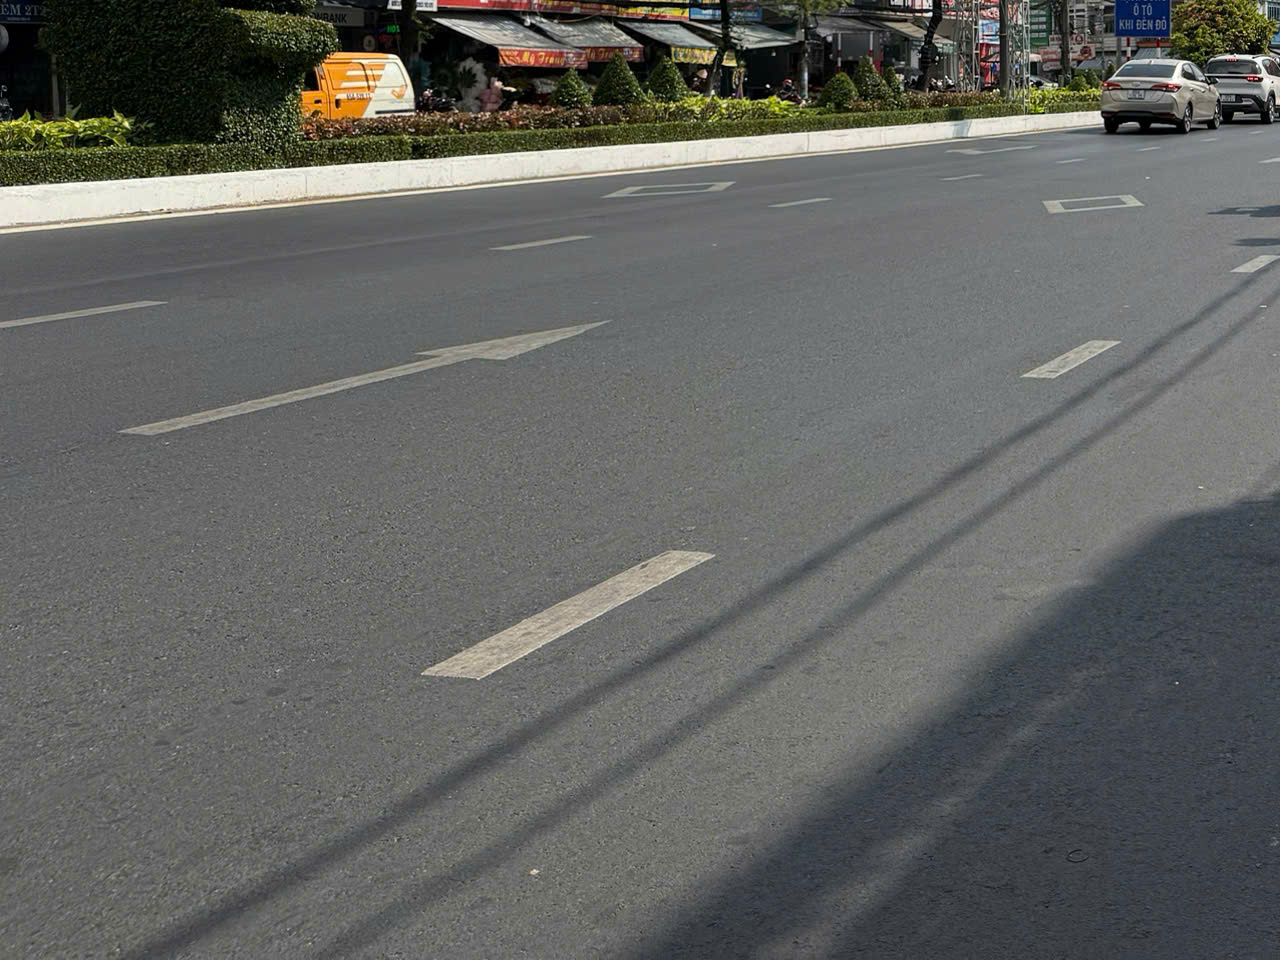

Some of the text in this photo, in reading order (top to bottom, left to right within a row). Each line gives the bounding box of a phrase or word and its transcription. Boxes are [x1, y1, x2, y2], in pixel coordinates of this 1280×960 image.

[1133, 3, 1153, 16] Ô TÔ
[1118, 16, 1167, 30] KHI ĐÈN ĐỎ
